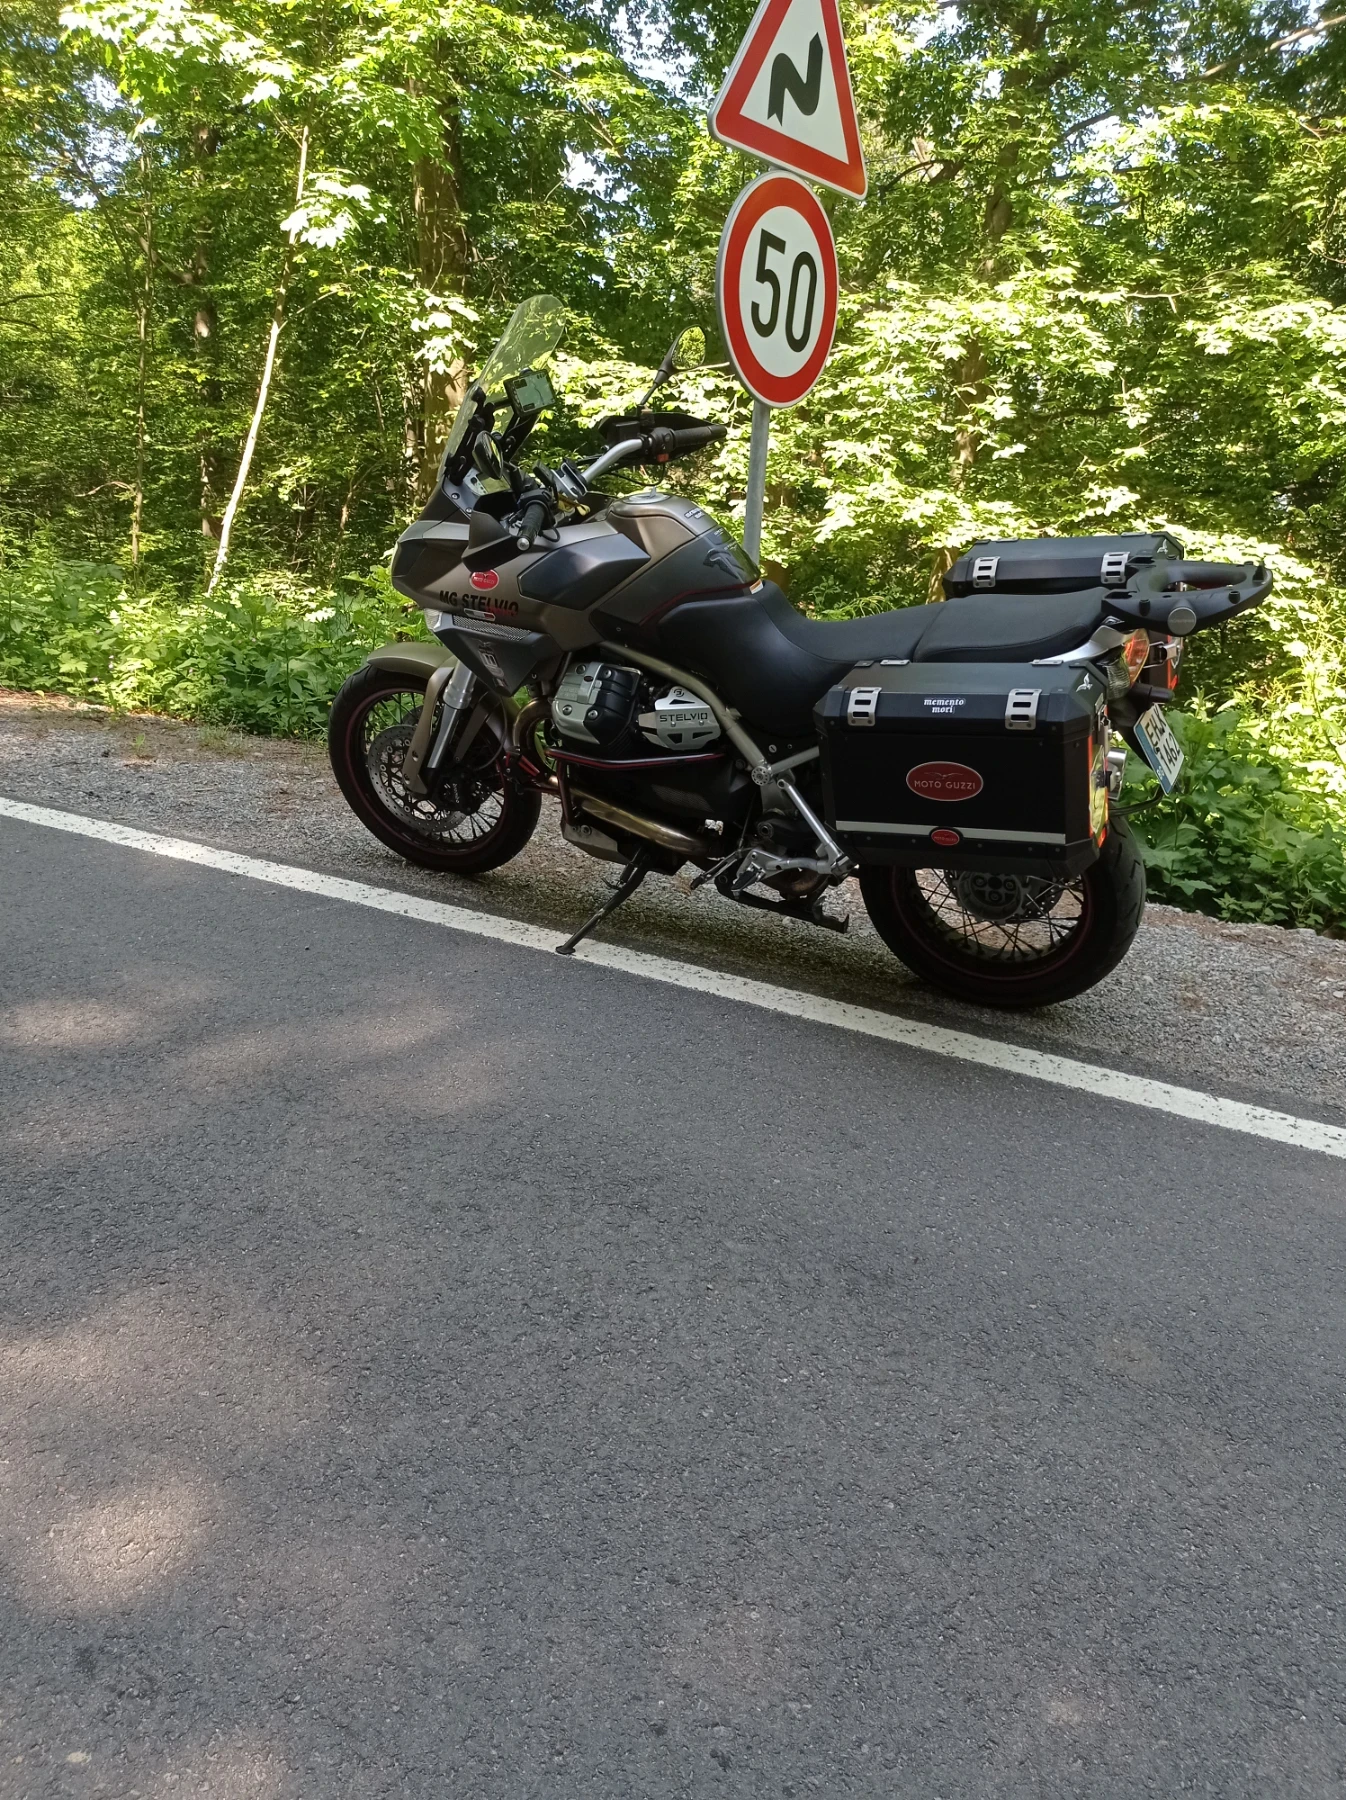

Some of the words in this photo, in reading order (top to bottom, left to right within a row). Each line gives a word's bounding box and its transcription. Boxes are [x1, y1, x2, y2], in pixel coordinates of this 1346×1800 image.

[750, 228, 817, 353] 50
[440, 590, 458, 606] MG
[462, 593, 519, 615] STELVIO
[924, 698, 965, 706] memento
[932, 705, 954, 713] mori
[659, 712, 708, 722] STELVIO
[1159, 732, 1181, 774] 1462
[914, 780, 942, 789] MOTO
[945, 781, 976, 790] GUZZI
